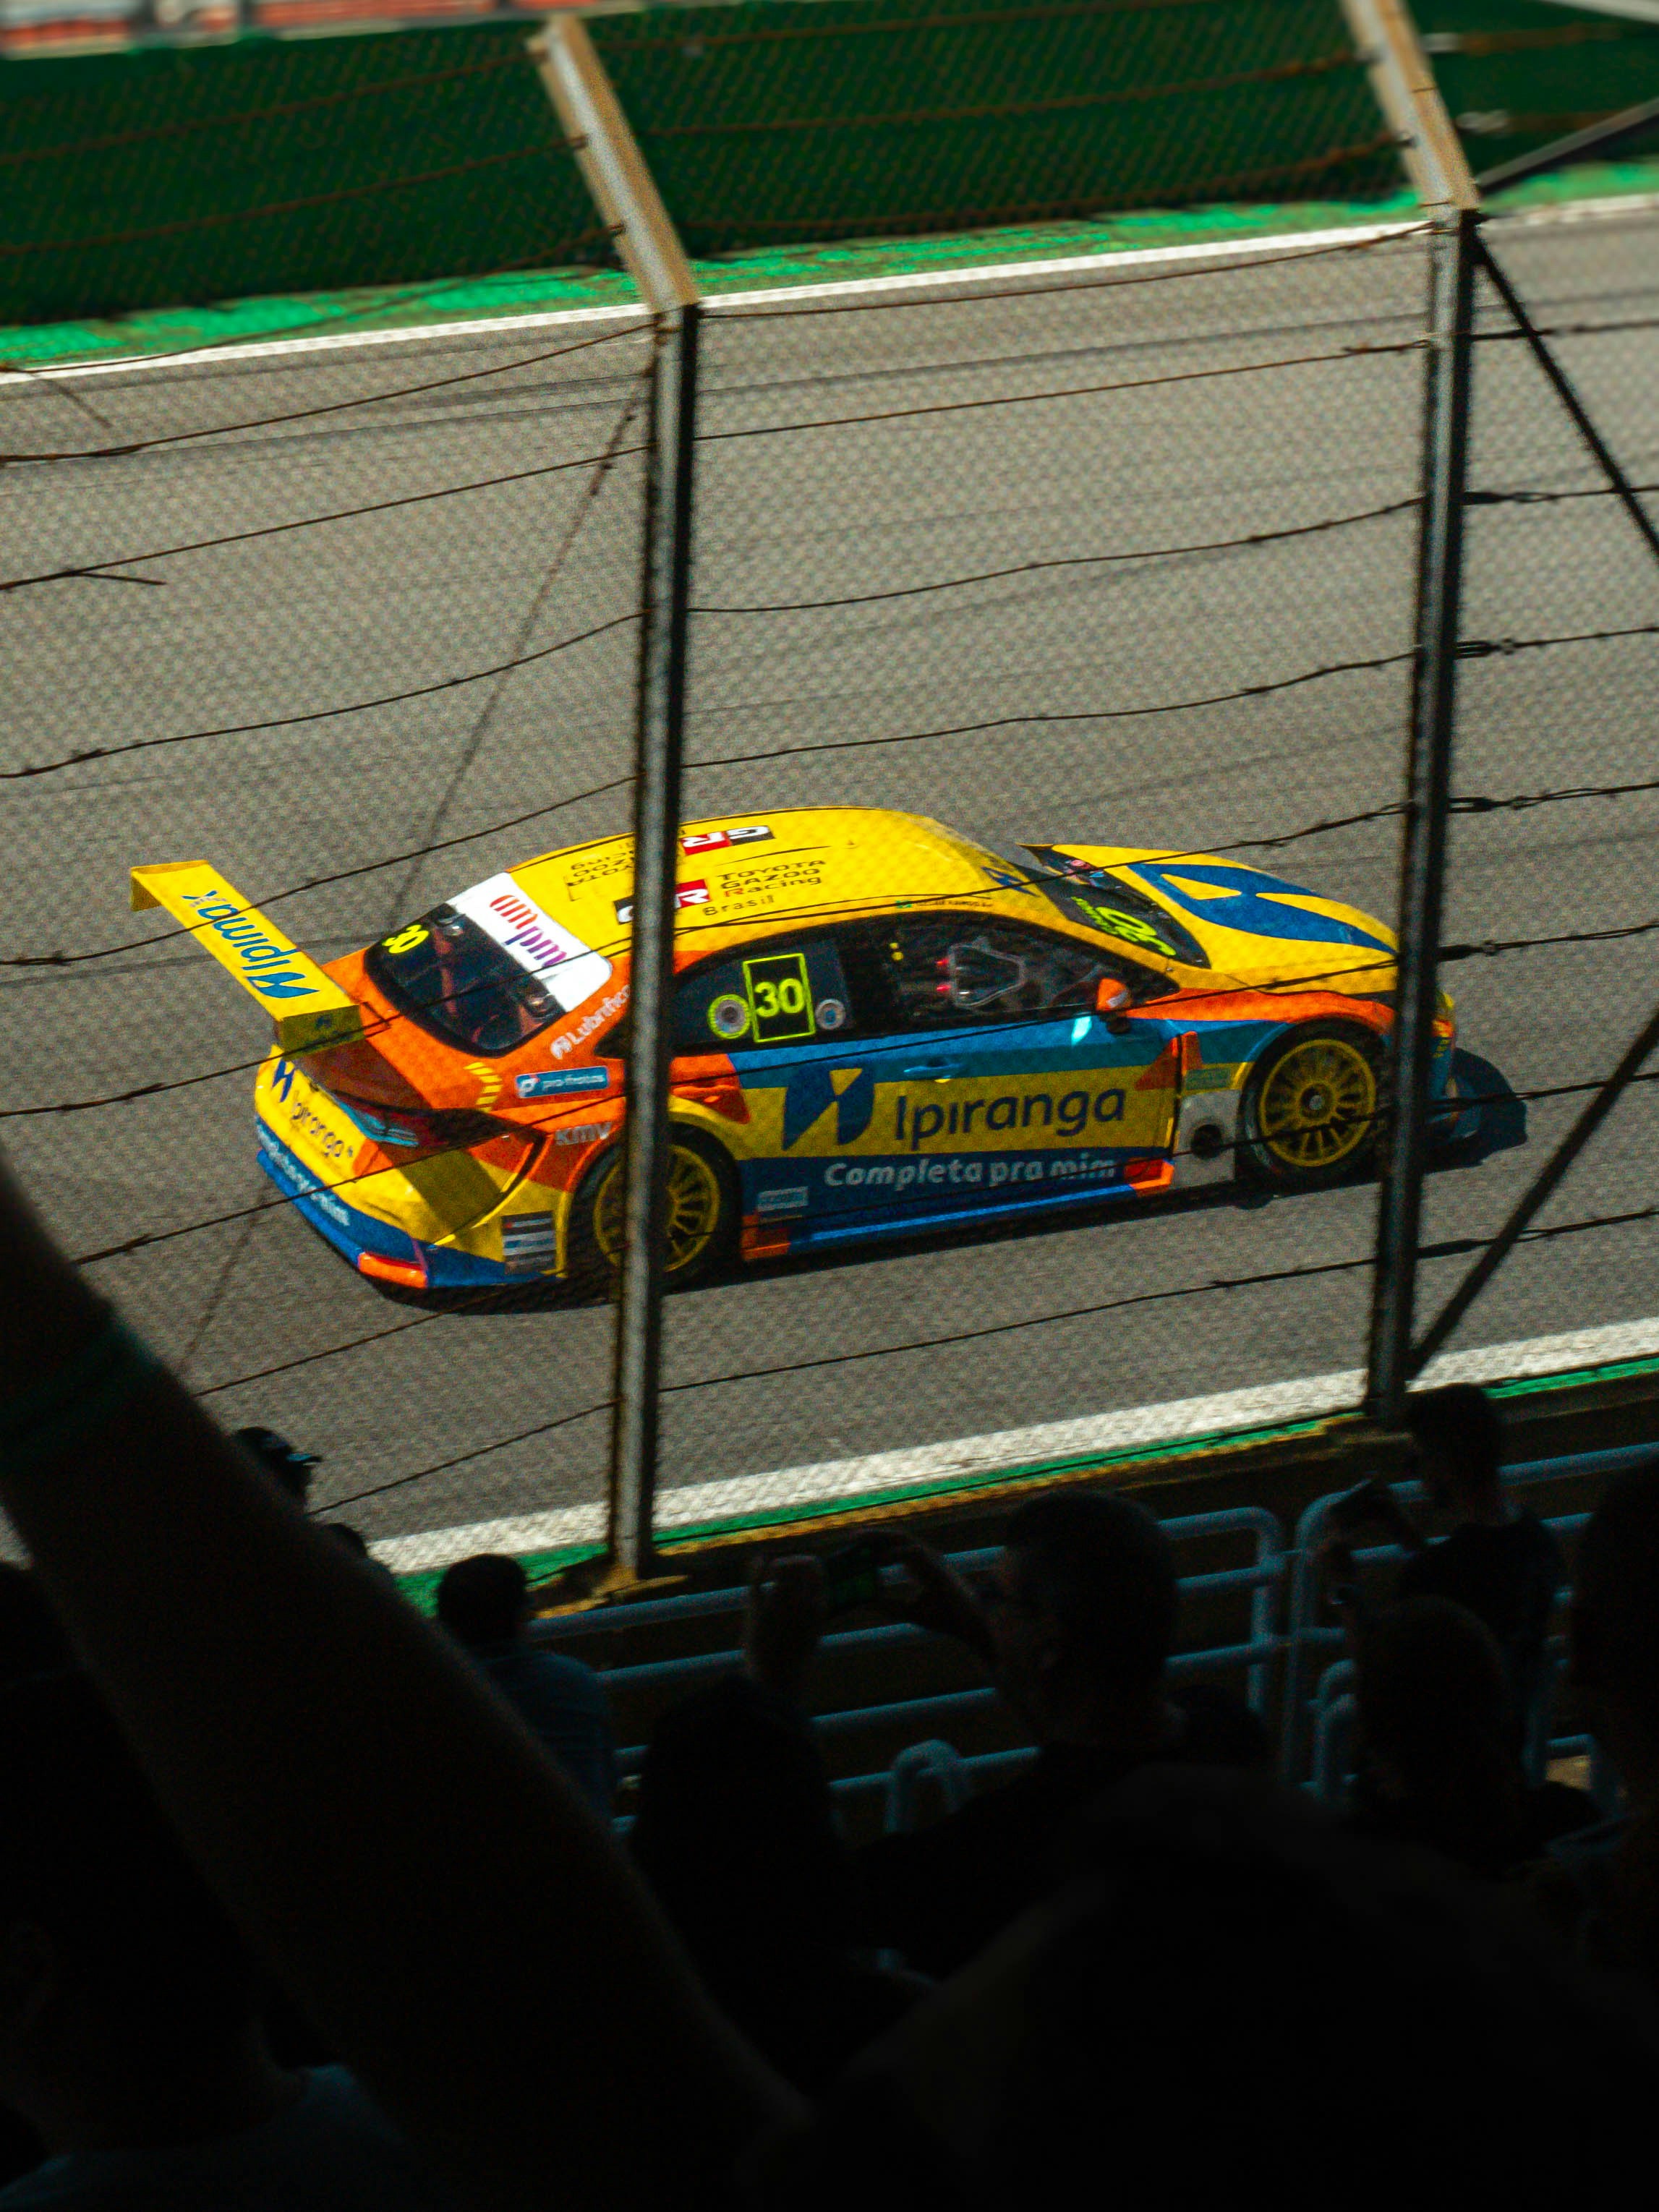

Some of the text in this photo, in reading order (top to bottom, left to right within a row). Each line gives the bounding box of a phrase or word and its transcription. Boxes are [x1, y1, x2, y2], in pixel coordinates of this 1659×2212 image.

[717, 861, 826, 881] TOYOTA
[721, 868, 820, 889] GAZOO
[725, 877, 822, 897] Racing
[702, 894, 775, 915] Brasil
[754, 978, 806, 1017] 30
[895, 1088, 1126, 1151] Ipiranga
[824, 1152, 1115, 1192] Completa pra mim
